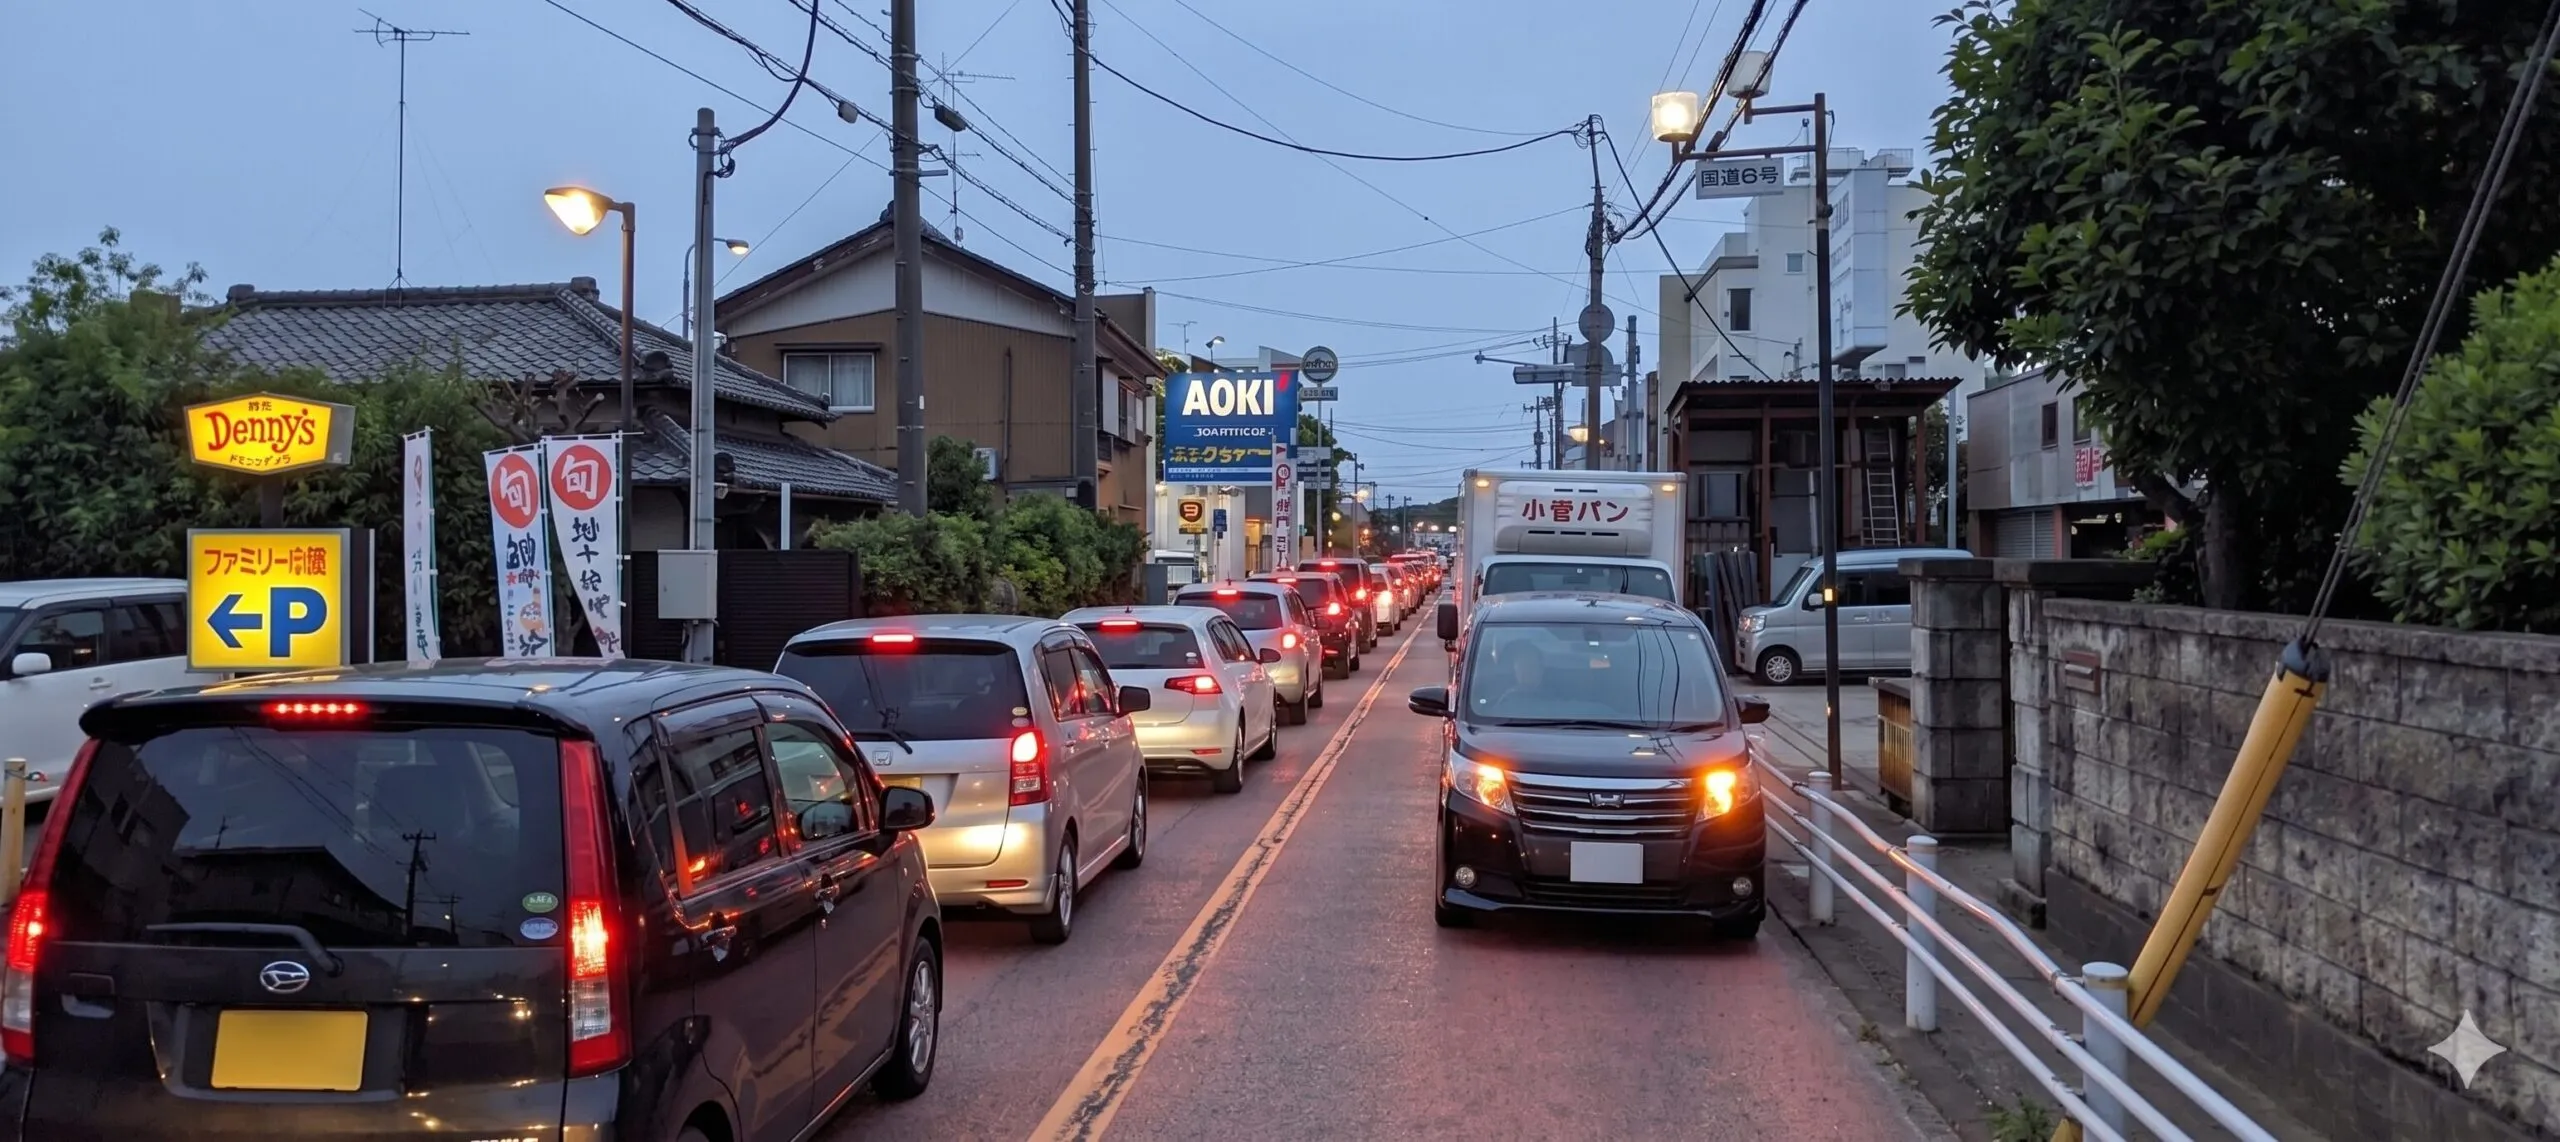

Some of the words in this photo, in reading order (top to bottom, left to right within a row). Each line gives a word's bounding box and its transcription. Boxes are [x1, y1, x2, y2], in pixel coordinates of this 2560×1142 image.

[1701, 166, 1779, 188] 国道6号
[1182, 379, 1274, 416] AOKI
[204, 408, 316, 454] Denny's
[499, 465, 532, 516] 旬
[557, 453, 599, 500] 旬
[269, 586, 328, 658] P
